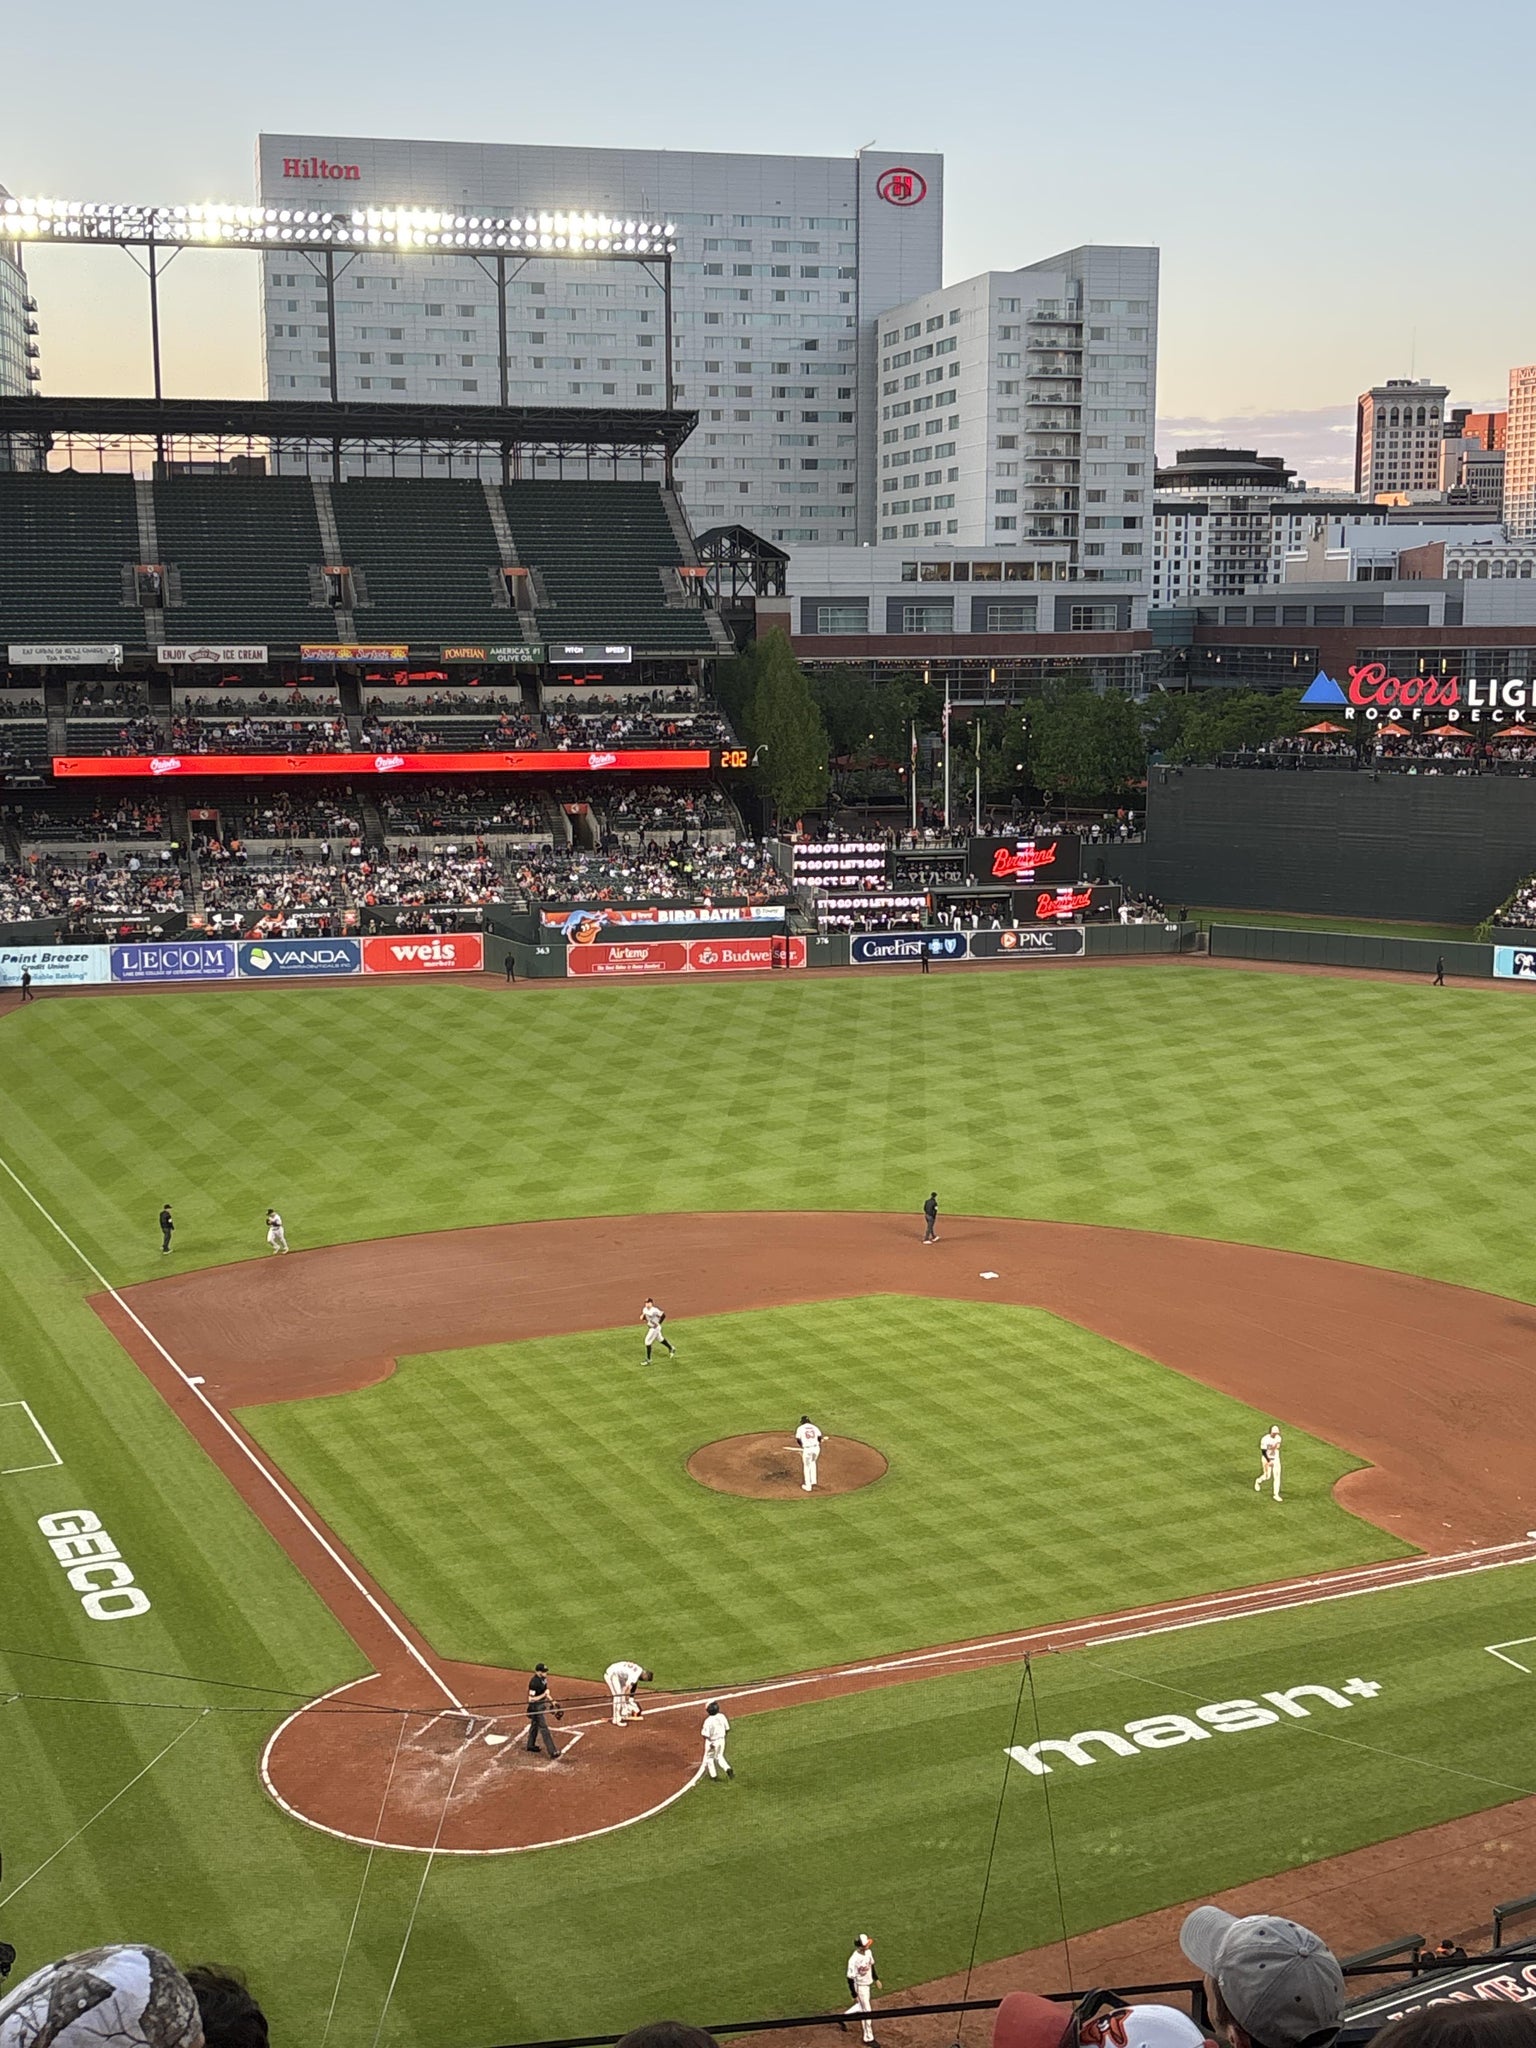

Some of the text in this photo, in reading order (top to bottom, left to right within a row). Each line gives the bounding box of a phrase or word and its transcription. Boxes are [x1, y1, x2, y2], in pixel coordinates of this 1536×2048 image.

[282, 157, 361, 180] Hilton
[162, 649, 187, 660] ENJOY
[223, 649, 235, 660] ICE
[238, 649, 263, 660] CREAM
[445, 648, 486, 660] POMPEIAN
[490, 647, 530, 655] AMERICA'S
[497, 654, 533, 662] OLIVE OIL
[1348, 663, 1461, 706] Coors
[1345, 707, 1526, 722] ROOF DECK
[720, 751, 748, 767] 2:02
[292, 911, 331, 919] protect
[658, 909, 697, 922] BIRD
[700, 907, 740, 920] BATH
[816, 936, 830, 945] 376
[1019, 932, 1054, 947] PNC
[390, 940, 456, 962] weis
[536, 947, 550, 955] 363
[609, 947, 649, 961] Airtemp
[863, 940, 926, 958] CareFirst
[1, 953, 89, 964] Point Breeze
[122, 950, 225, 969] LECOM
[273, 950, 351, 964] VANDA
[37, 1509, 152, 1620] GEICO
